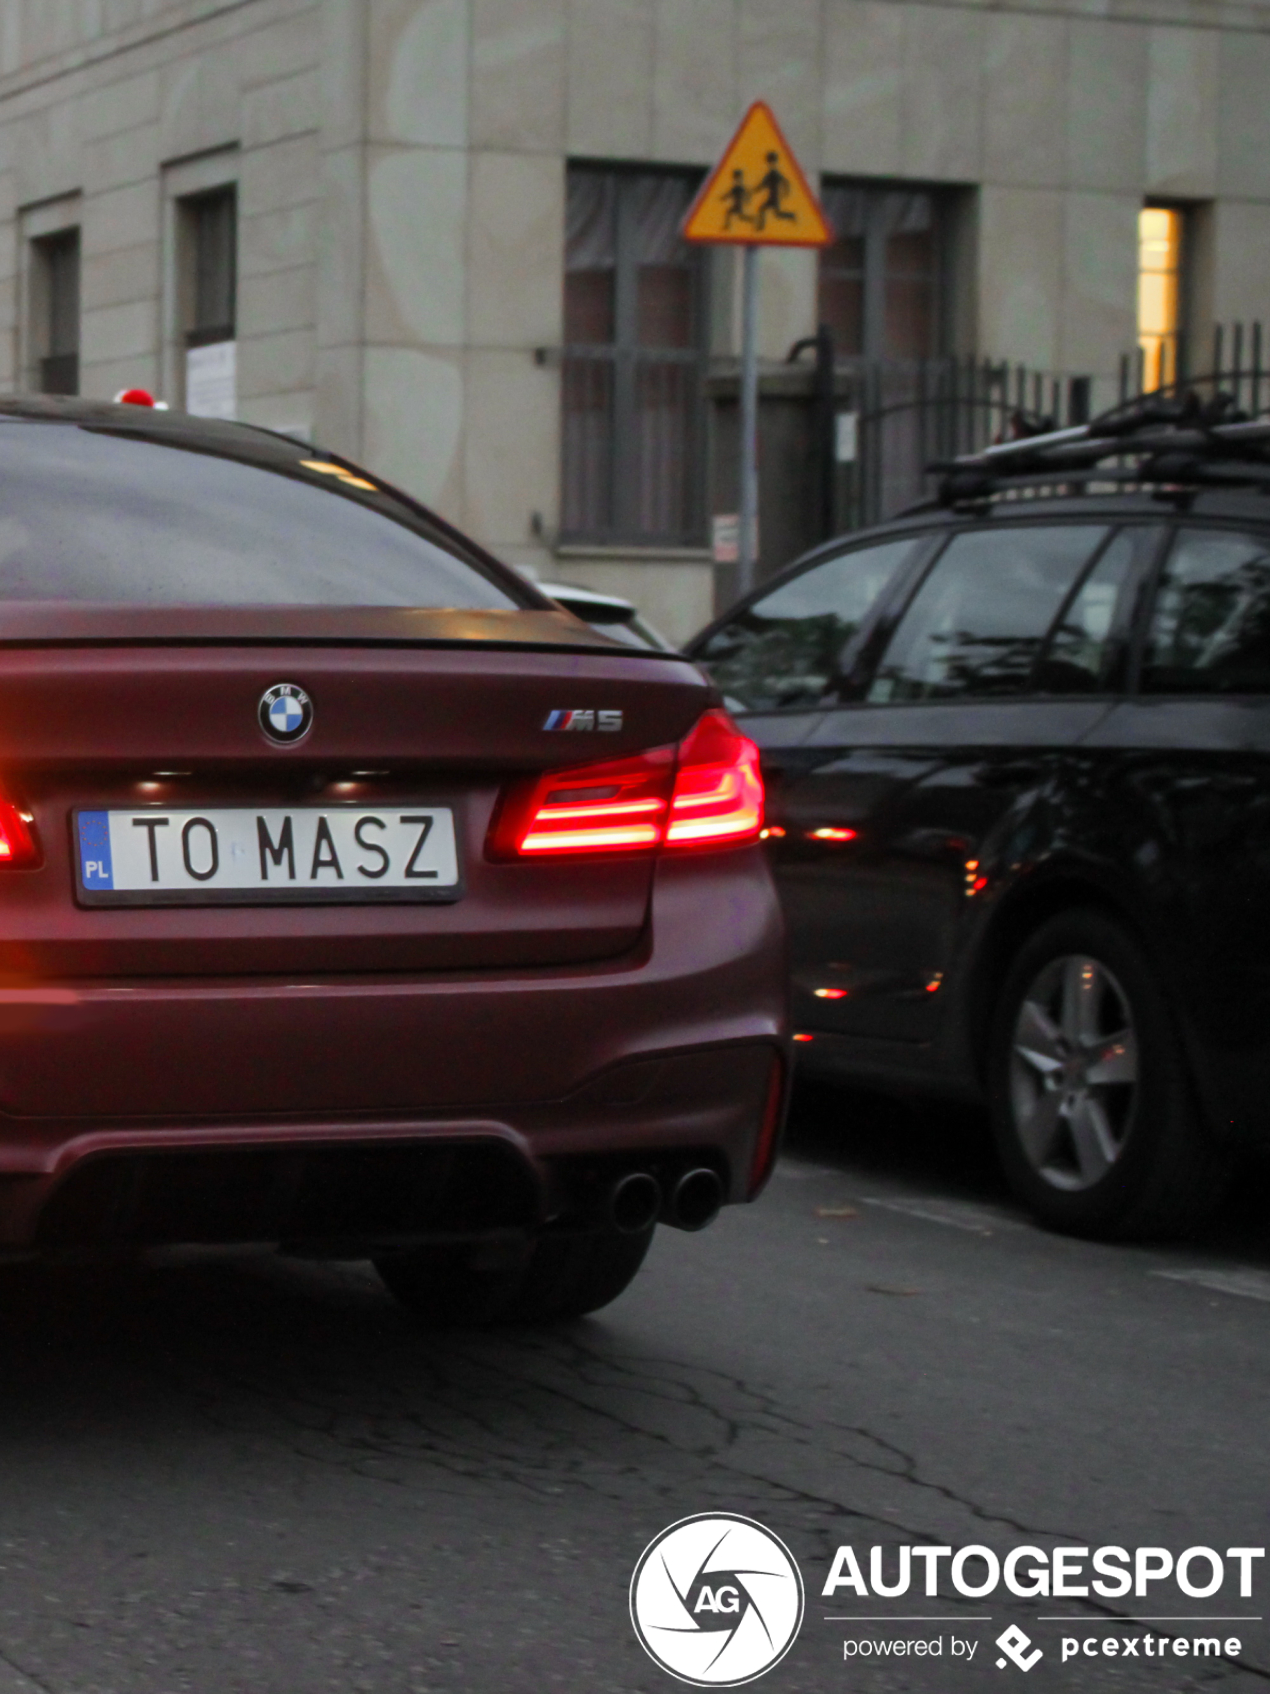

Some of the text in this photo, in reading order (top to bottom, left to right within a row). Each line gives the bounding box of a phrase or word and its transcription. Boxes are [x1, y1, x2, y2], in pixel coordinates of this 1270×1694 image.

[264, 686, 309, 704] BMW
[565, 709, 623, 731] M5
[132, 815, 439, 882] TO MASZ
[85, 861, 109, 879] PL
